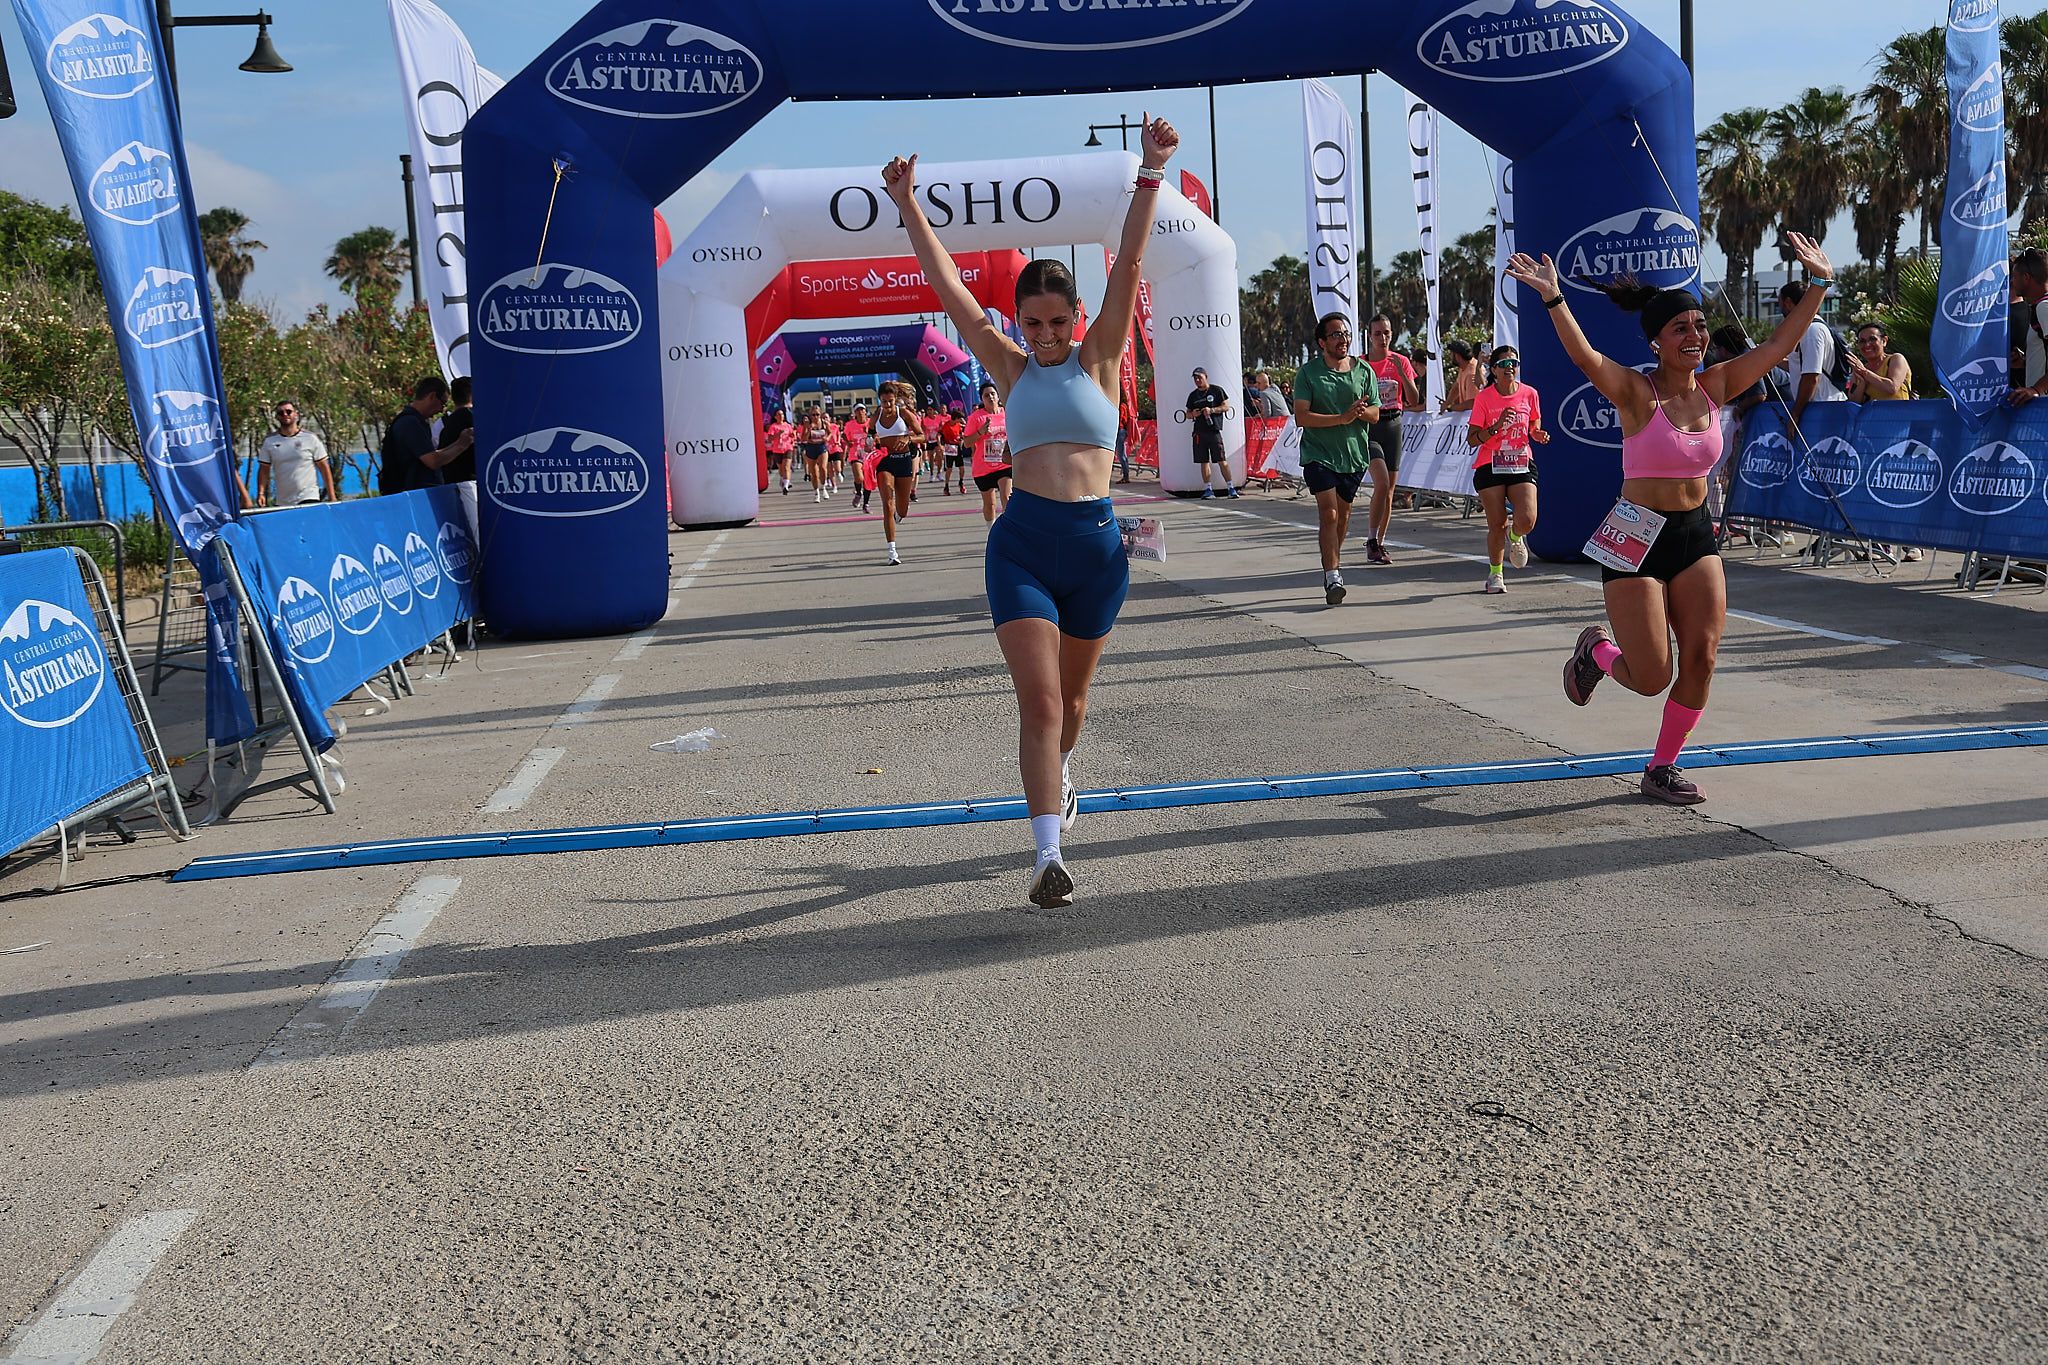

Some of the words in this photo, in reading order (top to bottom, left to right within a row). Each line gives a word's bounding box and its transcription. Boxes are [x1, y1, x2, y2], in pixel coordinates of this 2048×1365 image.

[1467, 17, 1538, 35] CENTRAL
[1544, 11, 1604, 24] LECHERA
[1435, 22, 1619, 64] ASTURIANA
[595, 52, 666, 63] CENTRAL
[673, 53, 743, 65] LECHERA
[559, 57, 747, 94] ASTURIANA
[1595, 237, 1654, 250] CENTRAL
[692, 246, 762, 263] OYSHO
[1568, 245, 1698, 278] ASTURIANA
[800, 274, 859, 296] Sports
[886, 267, 980, 288] Santer
[505, 295, 564, 304] CENTRAL
[570, 295, 627, 305] LECHERA
[485, 299, 633, 333] ASTURIANA
[1169, 313, 1232, 331] OYSHO
[830, 335, 863, 345] octopus
[669, 343, 733, 361] OYSHO
[676, 438, 739, 456] OYSHO
[514, 458, 571, 468] CENTRAL
[578, 457, 634, 466] LECHERA
[494, 461, 640, 494] ASTURIANA
[1871, 463, 1935, 492] ASTURIANA
[1953, 467, 2025, 497] ASTURIANA
[1602, 524, 1627, 544] 016
[14, 642, 49, 664] CENTRAL
